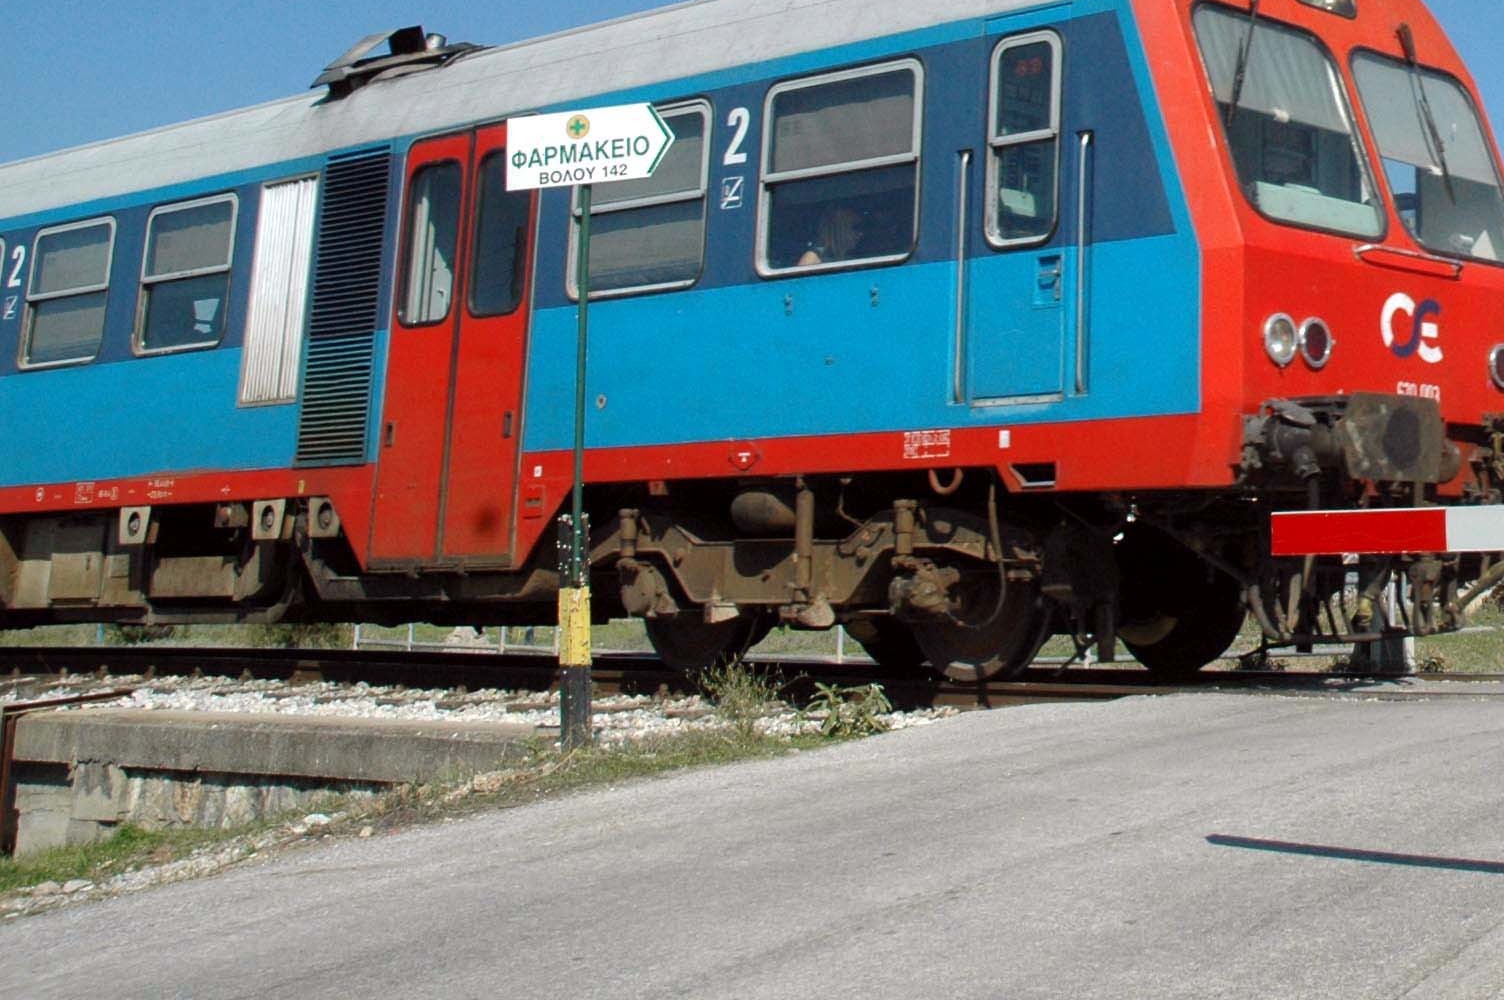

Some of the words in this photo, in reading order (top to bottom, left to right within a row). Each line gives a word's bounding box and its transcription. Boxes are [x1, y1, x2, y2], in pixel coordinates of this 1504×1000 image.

[511, 135, 650, 170] ΦΑΡΜΑΚΕΙΟ
[723, 106, 750, 166] 2
[538, 166, 596, 185] ΒΟΛΟΥ
[602, 163, 628, 178] 142
[7, 244, 26, 288] 2
